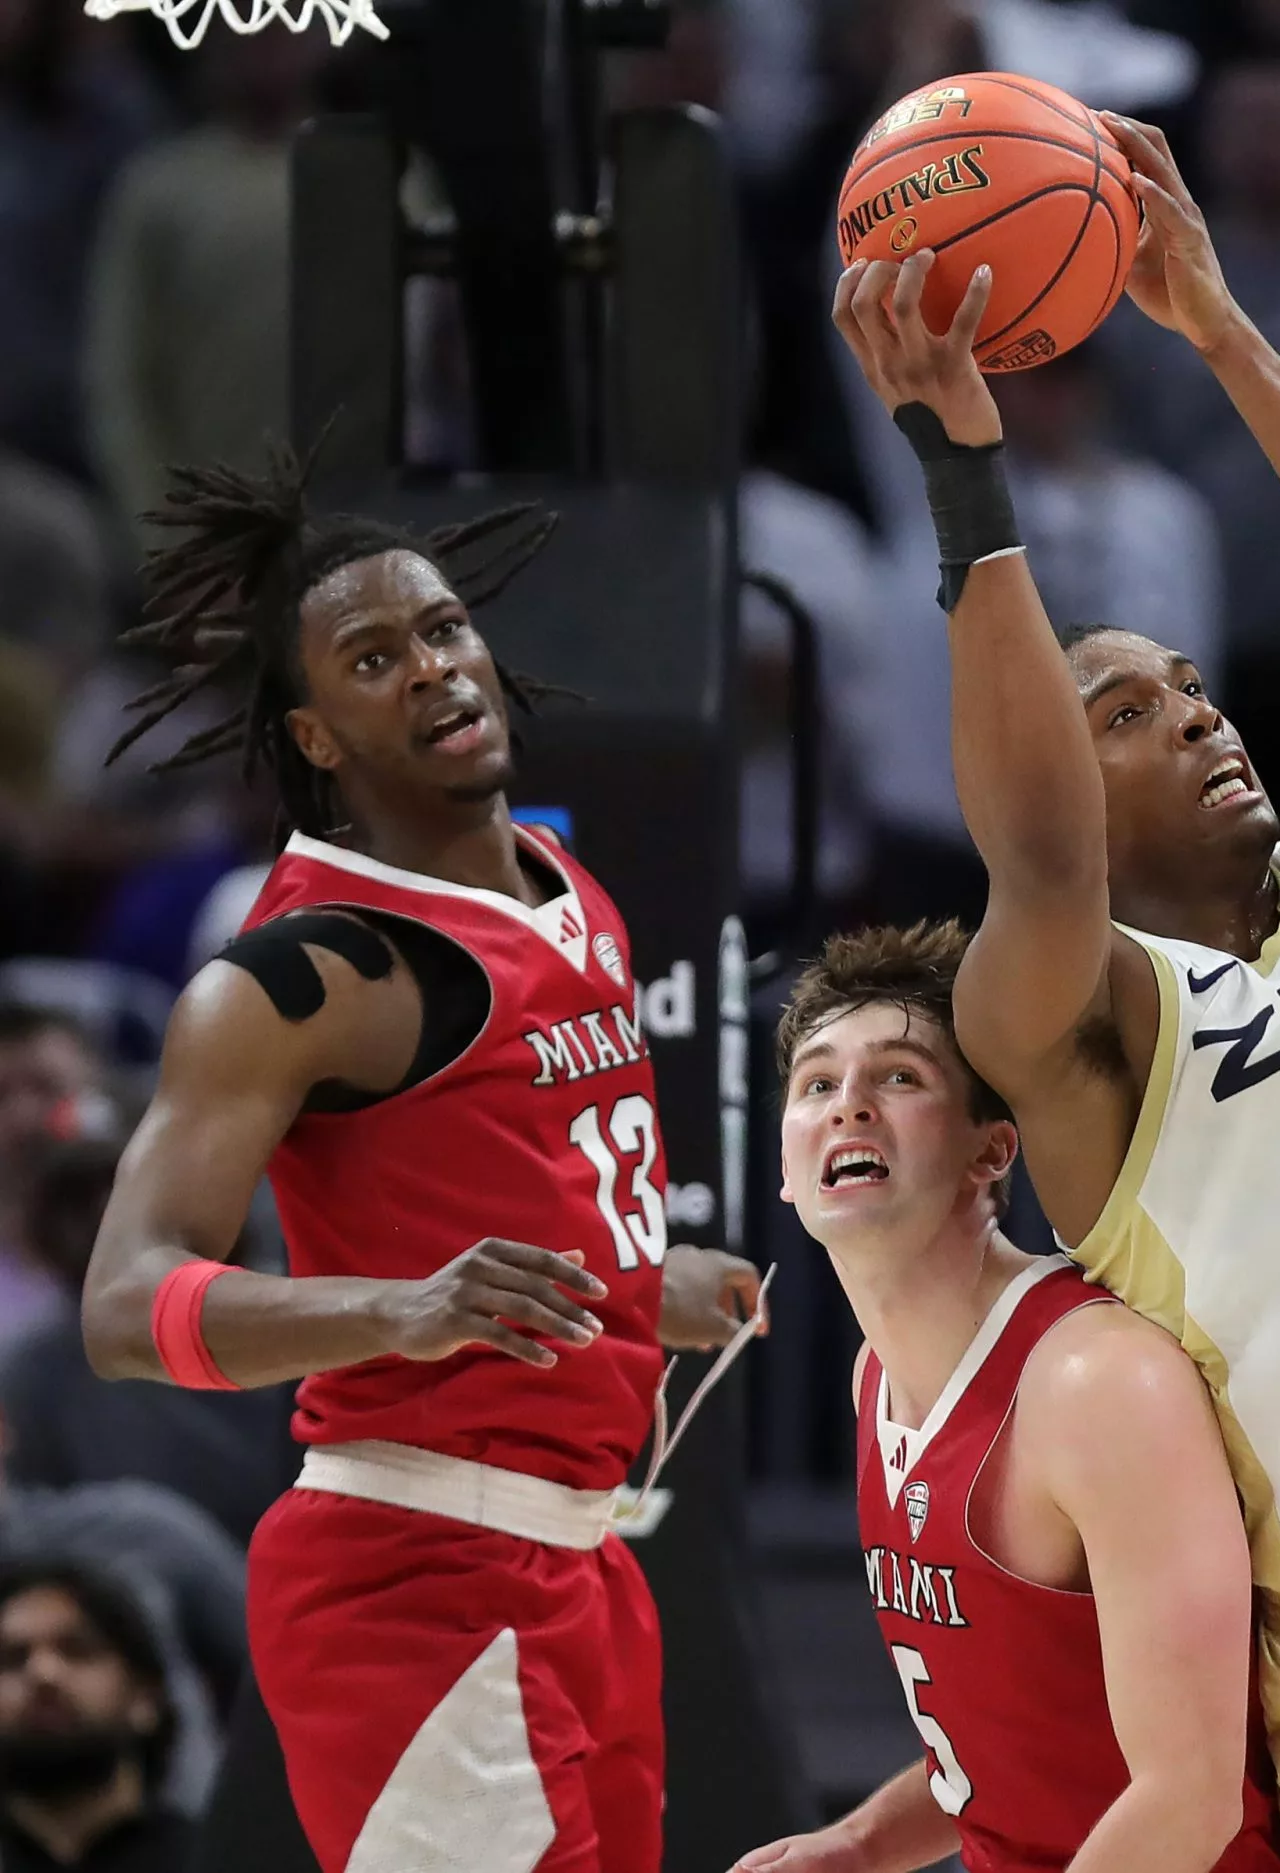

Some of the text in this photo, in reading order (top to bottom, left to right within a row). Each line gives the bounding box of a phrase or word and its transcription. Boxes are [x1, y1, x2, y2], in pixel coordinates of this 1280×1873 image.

[840, 144, 990, 259] SPALDING
[521, 1005, 651, 1087] MIAM
[569, 1092, 668, 1272] 13
[890, 1642, 973, 1817] 5
